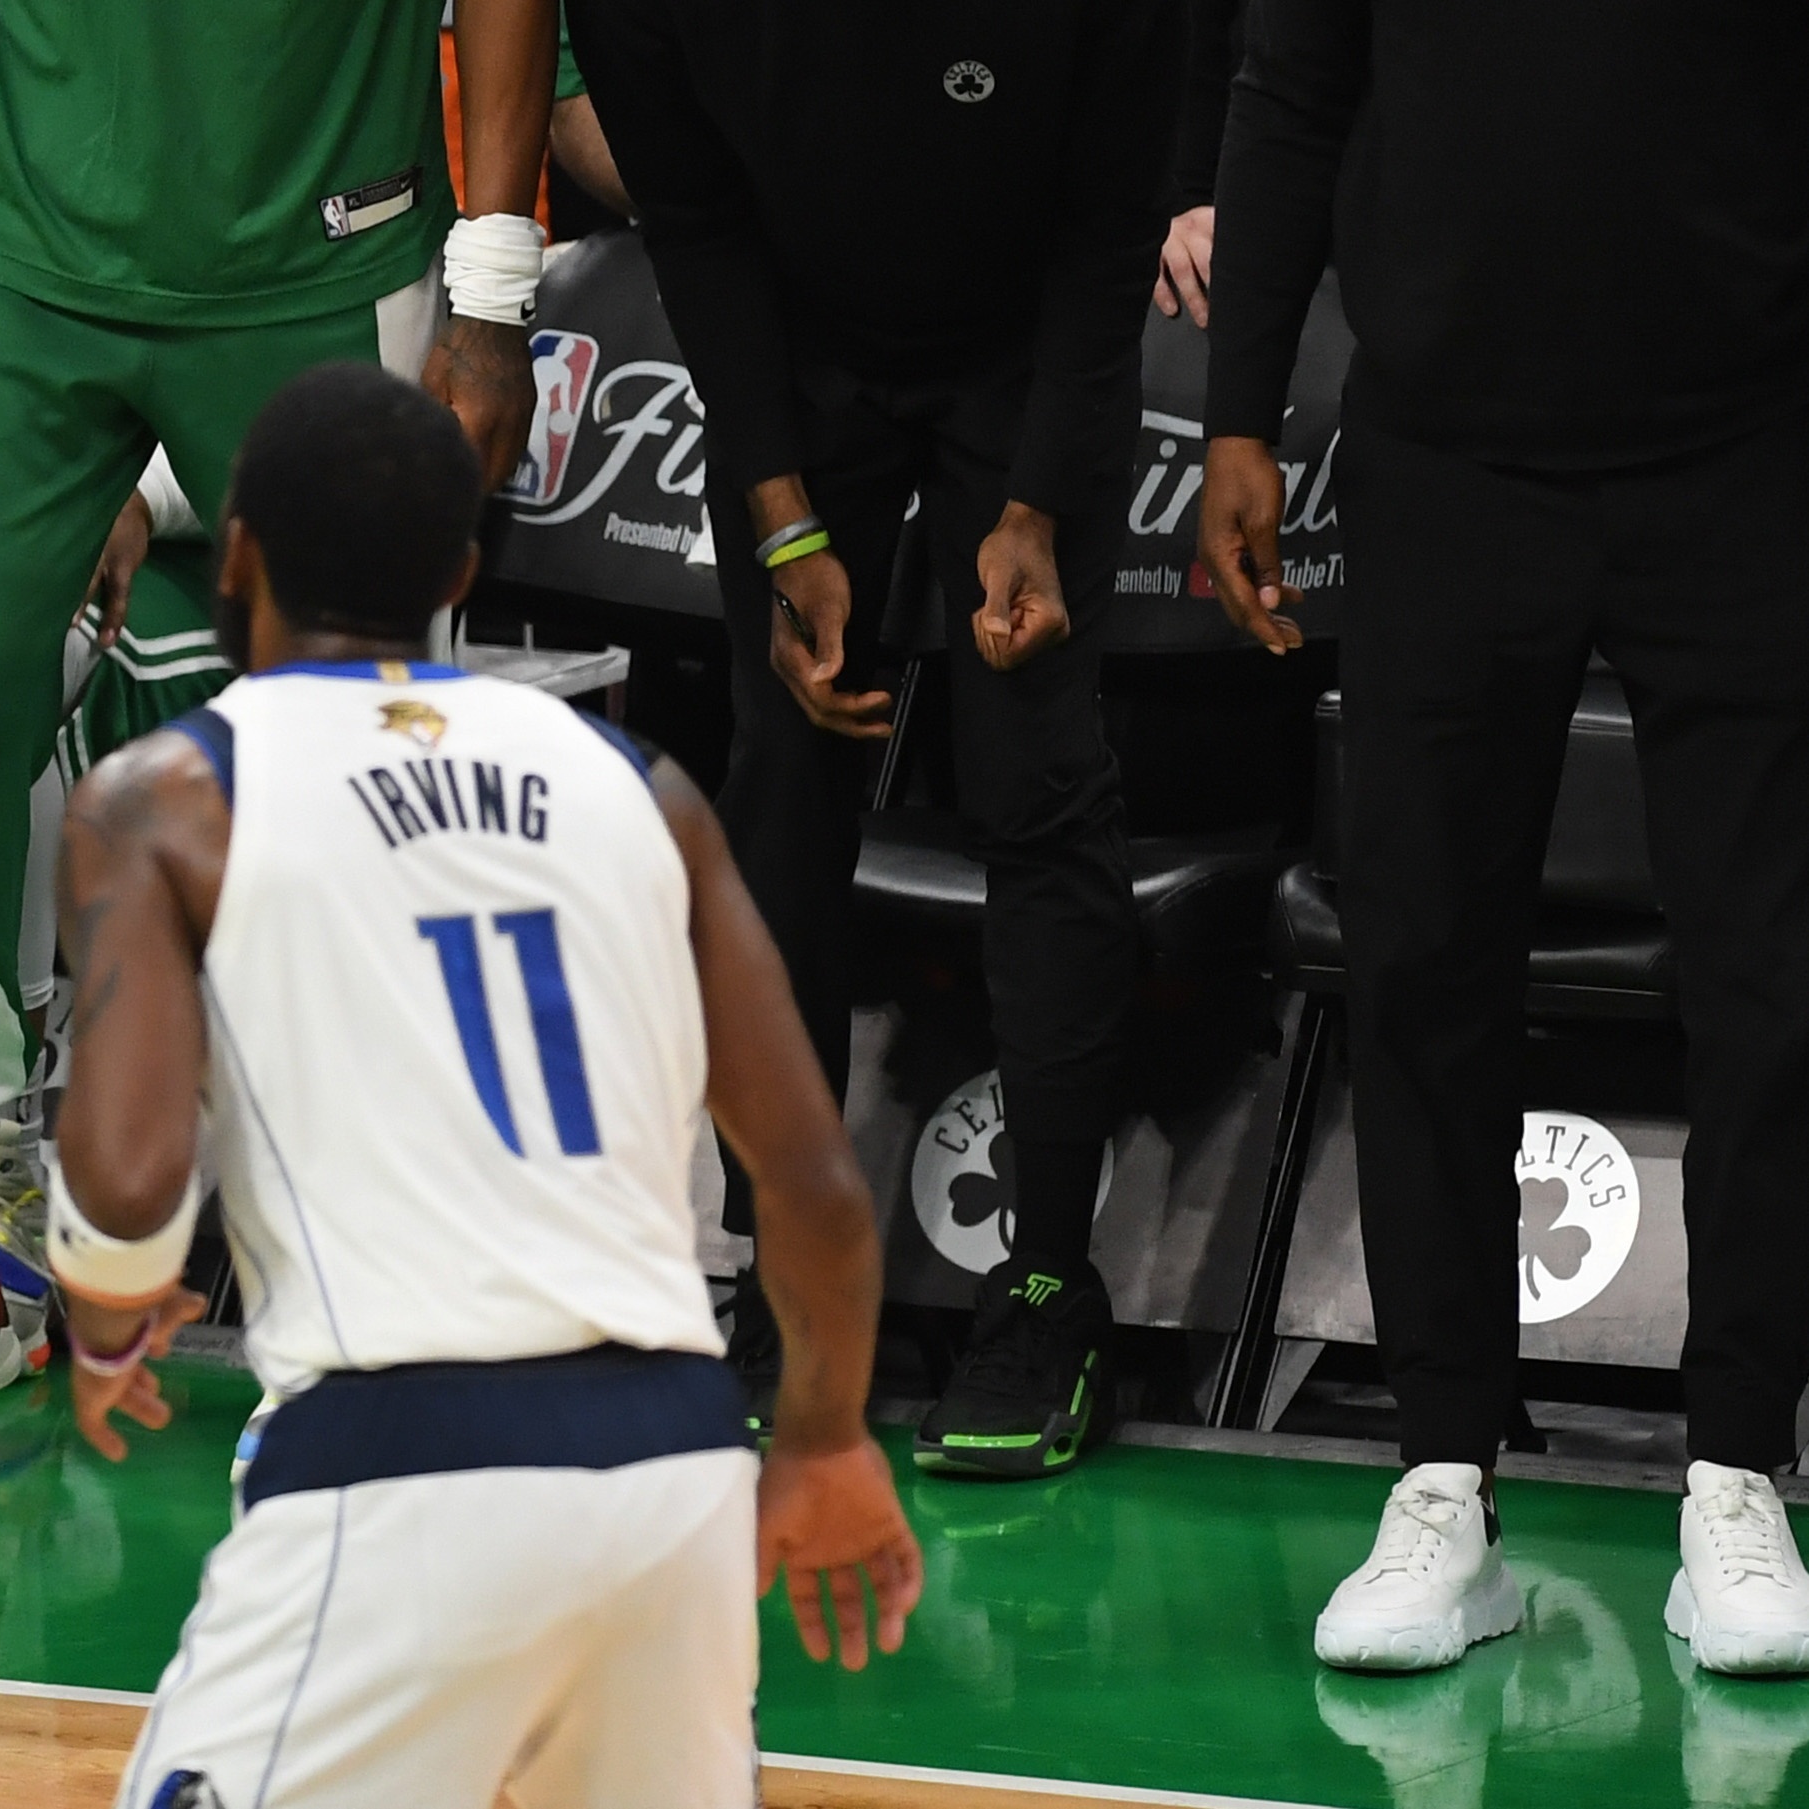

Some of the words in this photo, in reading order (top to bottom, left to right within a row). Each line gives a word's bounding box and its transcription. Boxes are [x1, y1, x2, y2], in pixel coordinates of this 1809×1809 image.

[603, 511, 682, 553] Presented
[1163, 565, 1182, 598] by
[347, 758, 550, 849] IRVING
[415, 906, 603, 1159] 11
